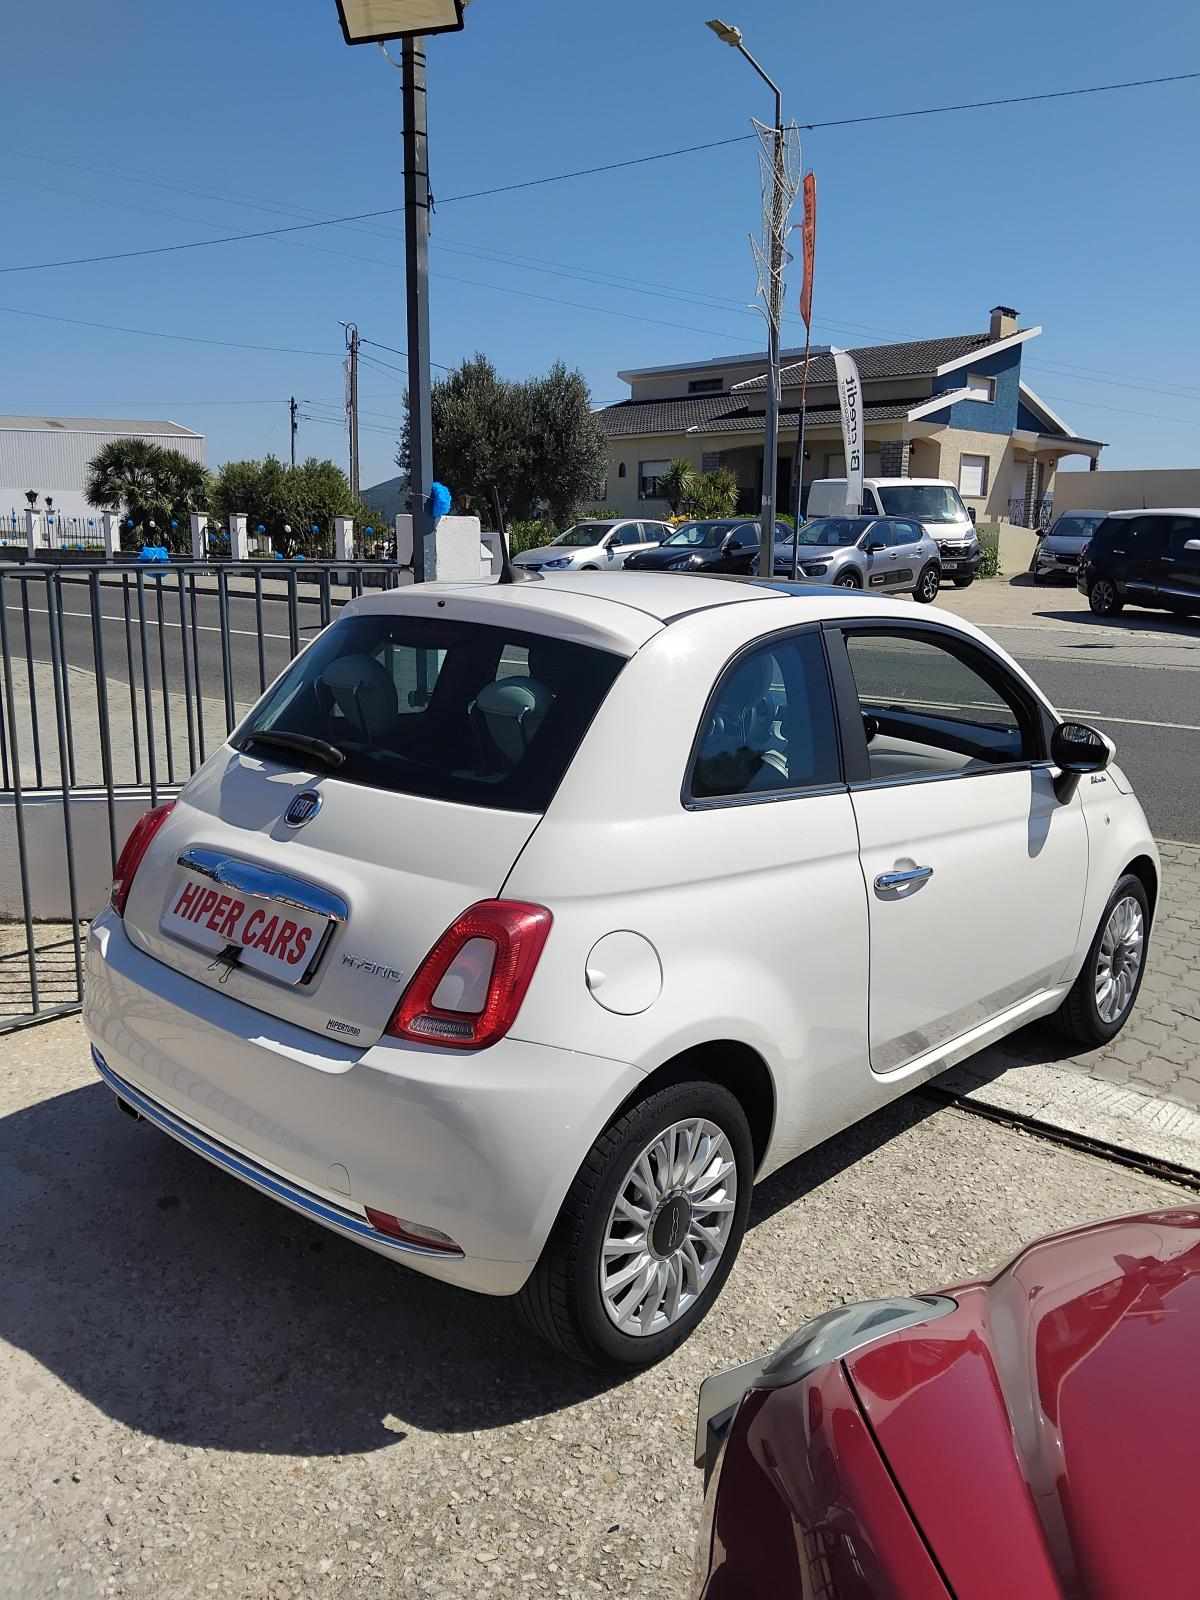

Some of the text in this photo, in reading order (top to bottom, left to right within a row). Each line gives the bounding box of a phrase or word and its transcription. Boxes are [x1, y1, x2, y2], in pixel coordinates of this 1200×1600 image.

[174, 881, 312, 965] HIPER CARS
[328, 1018, 360, 1035] HIPERTURBO
